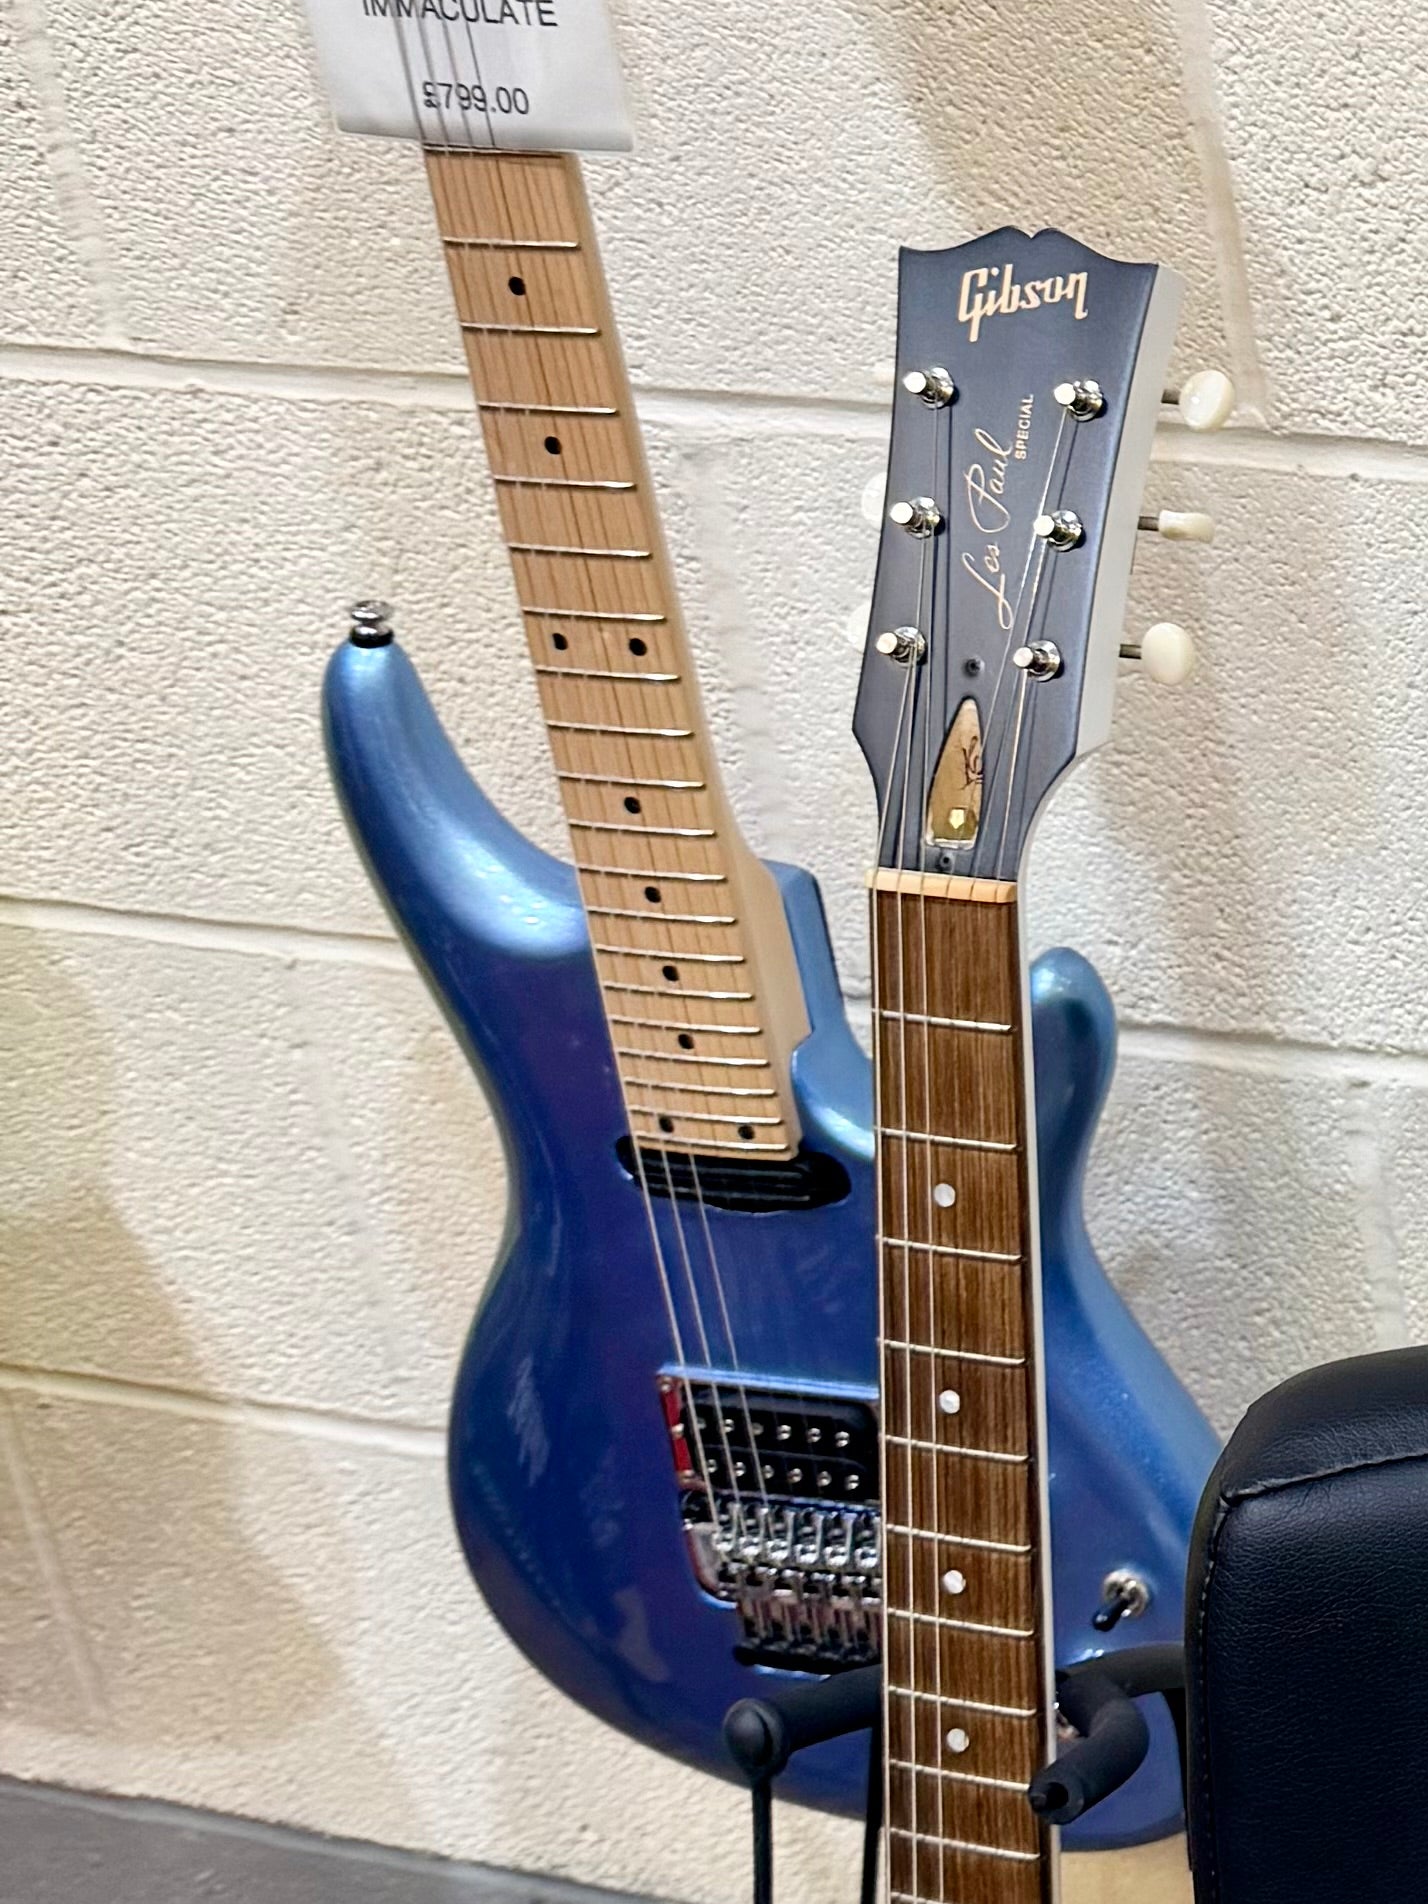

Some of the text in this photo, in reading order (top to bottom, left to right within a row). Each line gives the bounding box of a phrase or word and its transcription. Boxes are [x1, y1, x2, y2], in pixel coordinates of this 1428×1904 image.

[424, 84, 529, 114] £799.00
[958, 263, 1089, 343] Gibson
[1014, 393, 1035, 461] SPECIAL
[961, 428, 1014, 631] Les Paul
